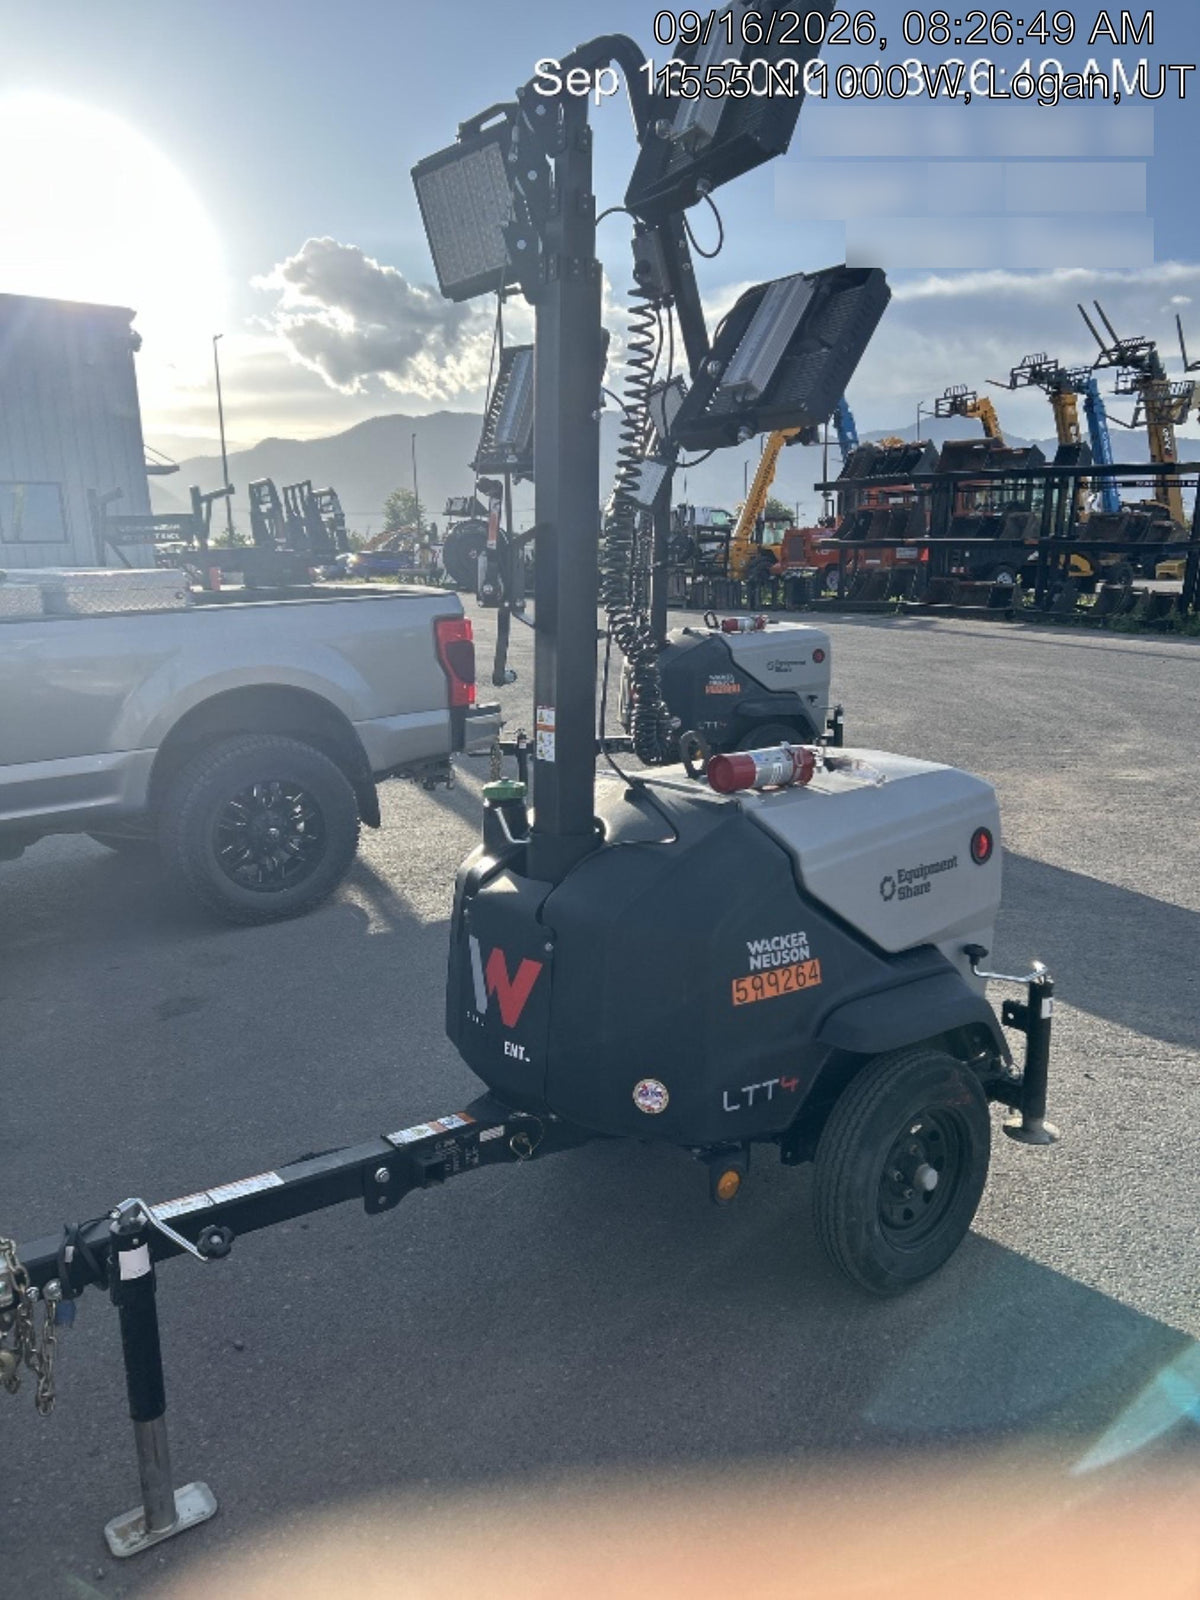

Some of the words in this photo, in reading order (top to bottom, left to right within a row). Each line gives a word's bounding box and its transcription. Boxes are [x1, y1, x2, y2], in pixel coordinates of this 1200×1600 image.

[897, 854, 958, 884] Equipment
[897, 881, 931, 900] Share
[746, 931, 809, 956] WACKER
[749, 946, 811, 971] NEUSON
[735, 961, 820, 1003] 599264
[722, 1075, 798, 1112] LTT4
